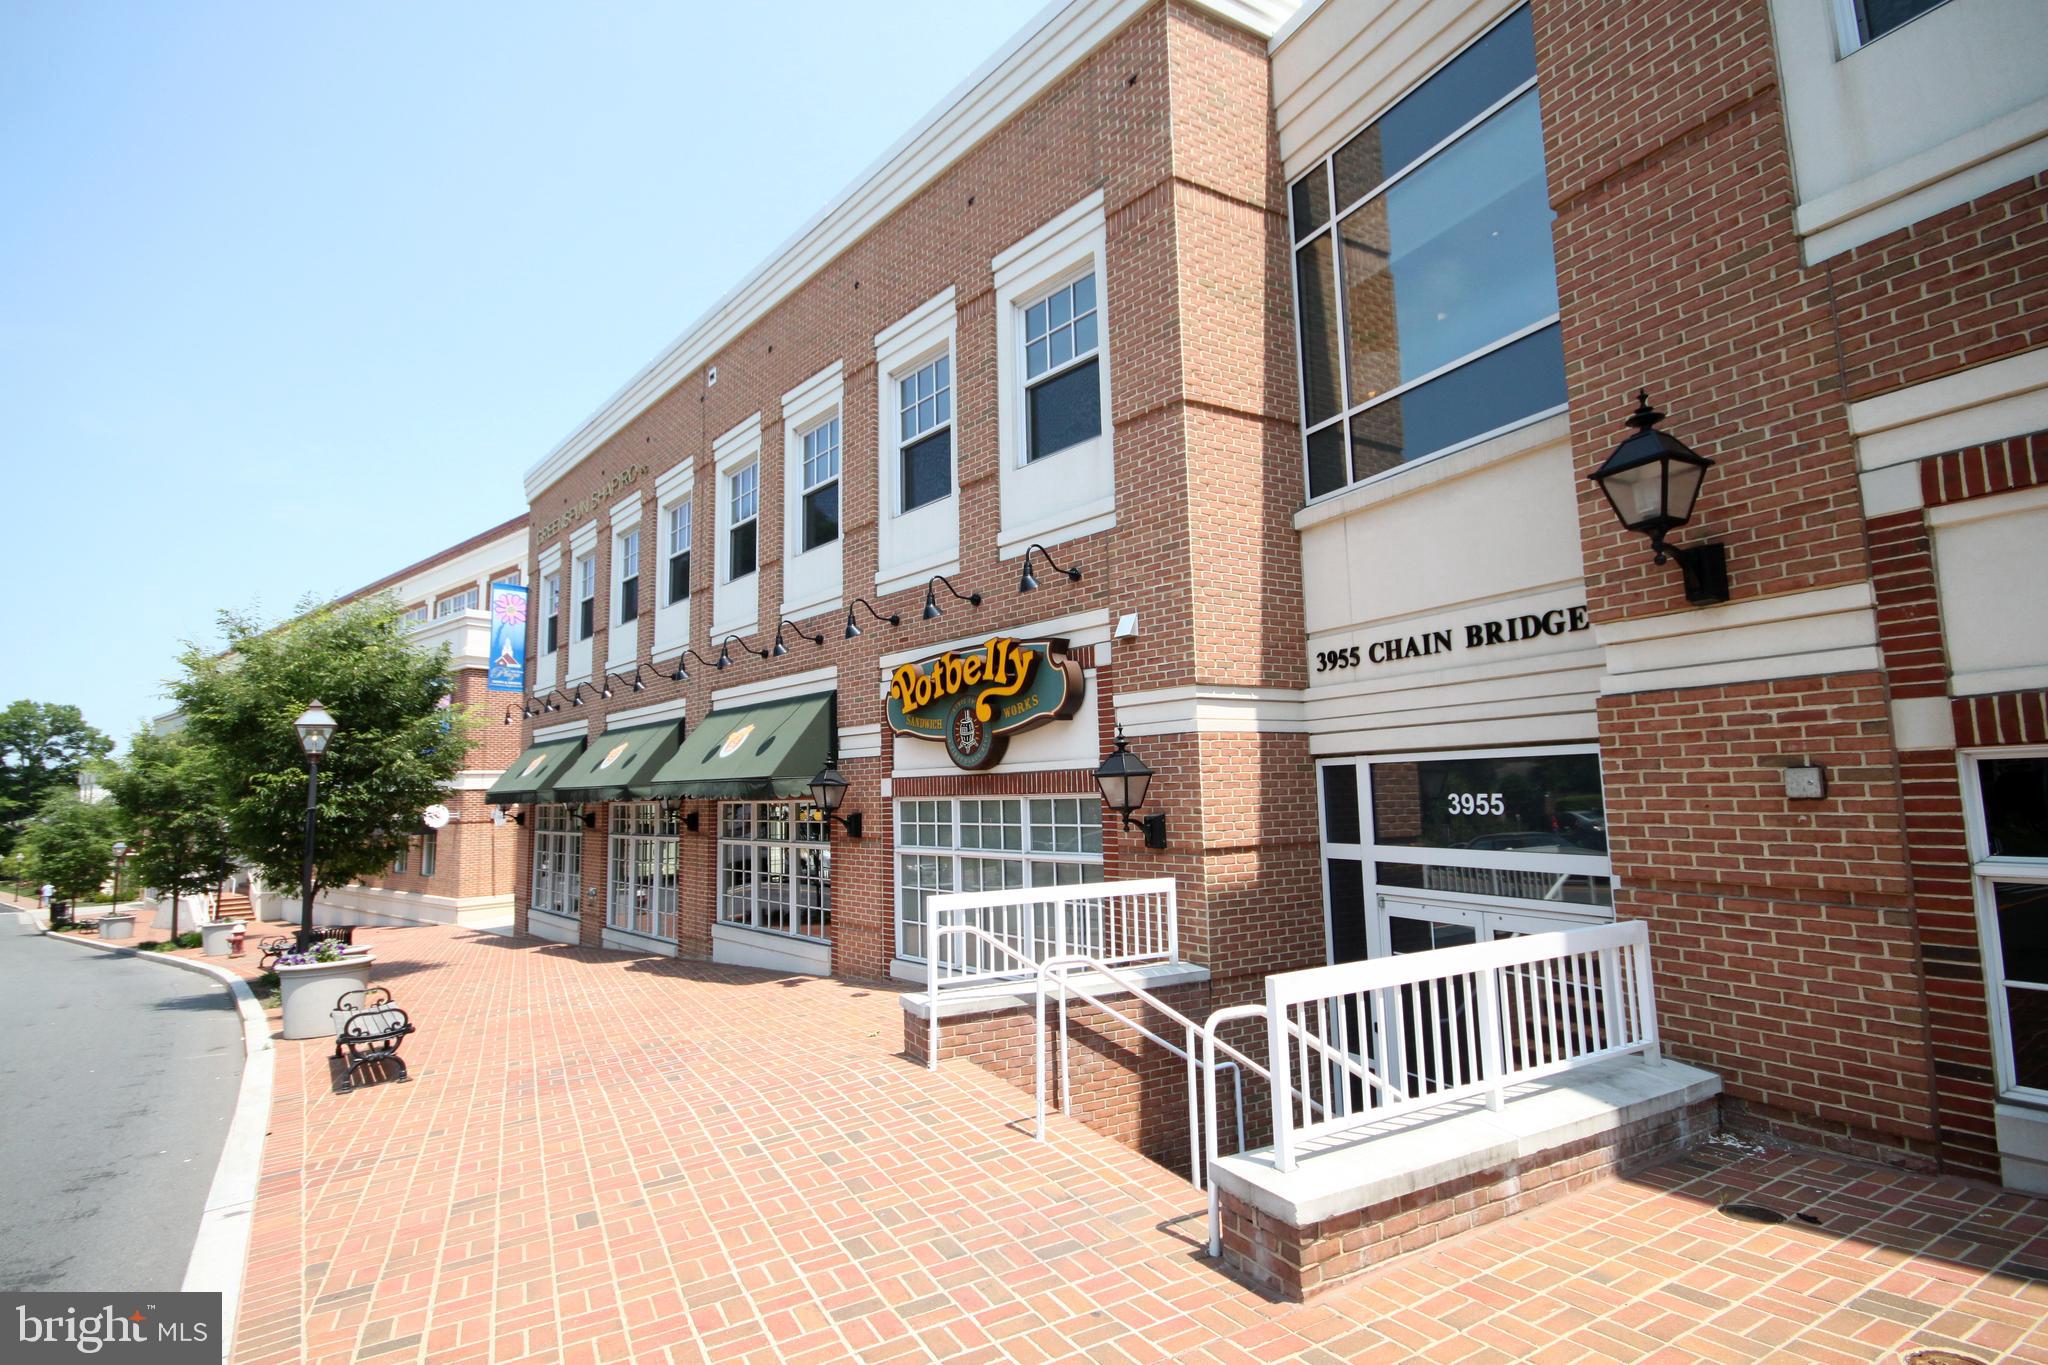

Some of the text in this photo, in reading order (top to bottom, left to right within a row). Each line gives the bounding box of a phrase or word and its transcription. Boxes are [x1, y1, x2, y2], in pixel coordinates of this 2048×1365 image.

[592, 464, 639, 508] SHAPIRO
[1316, 604, 1590, 672] 3955 CHAIN BRIDGE
[891, 637, 1034, 722] Potbelly
[906, 695, 1039, 729] SANDWICH WORKS
[1447, 792, 1505, 816] 3955
